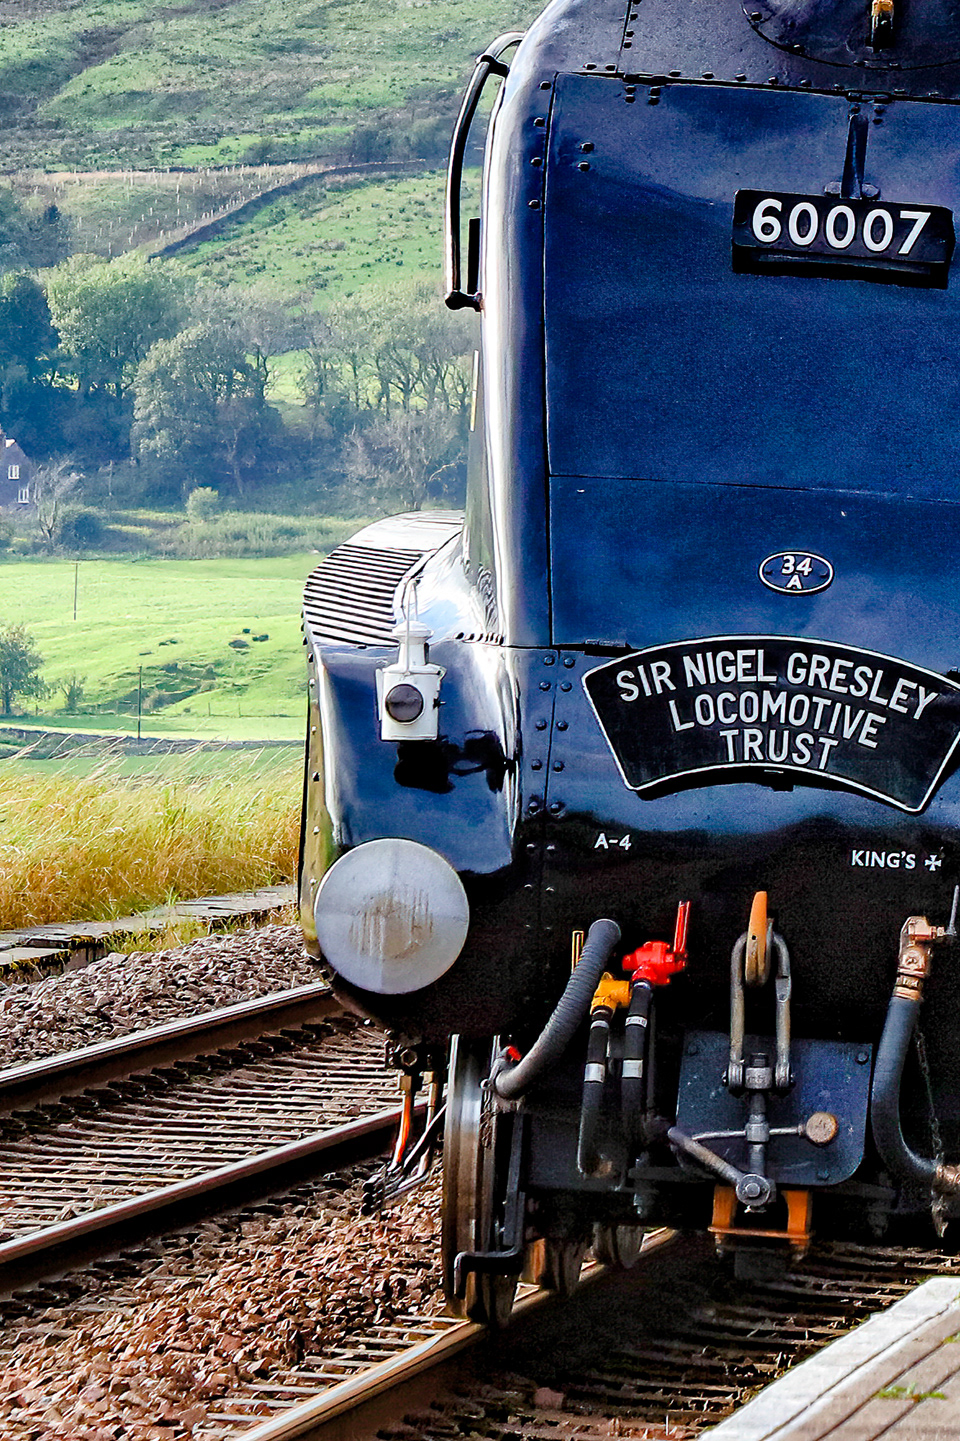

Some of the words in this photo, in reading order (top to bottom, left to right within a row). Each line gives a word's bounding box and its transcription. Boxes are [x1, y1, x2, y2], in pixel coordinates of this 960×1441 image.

[752, 198, 931, 254] 60007
[781, 555, 813, 576] 34
[785, 574, 802, 589] A
[616, 660, 675, 703] SIR
[683, 649, 777, 688] NIGEL
[787, 652, 938, 720] GRESLEY
[668, 690, 887, 749] LOCOMOTIVE
[719, 728, 839, 770] TRUST
[594, 832, 632, 851] A-4
[851, 849, 916, 870] KING'S
